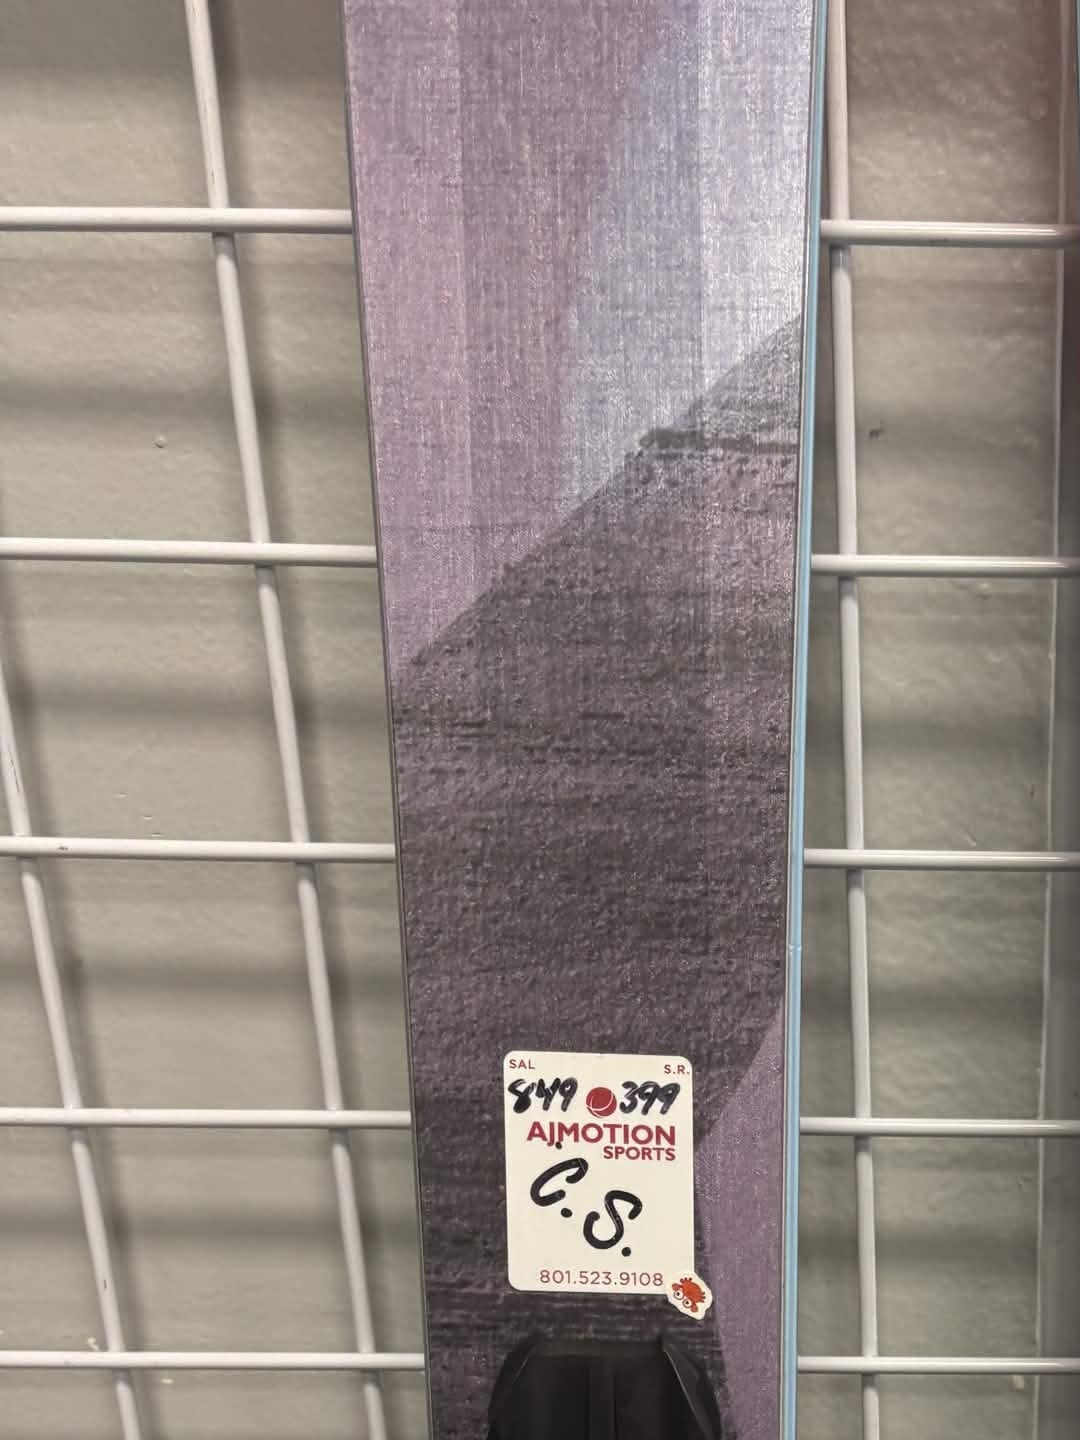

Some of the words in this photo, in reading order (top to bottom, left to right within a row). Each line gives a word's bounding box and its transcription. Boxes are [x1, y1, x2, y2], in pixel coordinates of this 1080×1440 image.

[509, 1058, 536, 1070] SAL
[526, 1121, 676, 1148] AJMOTION
[603, 1146, 676, 1161] SPORTS
[539, 1269, 664, 1287] 801.523.9108
